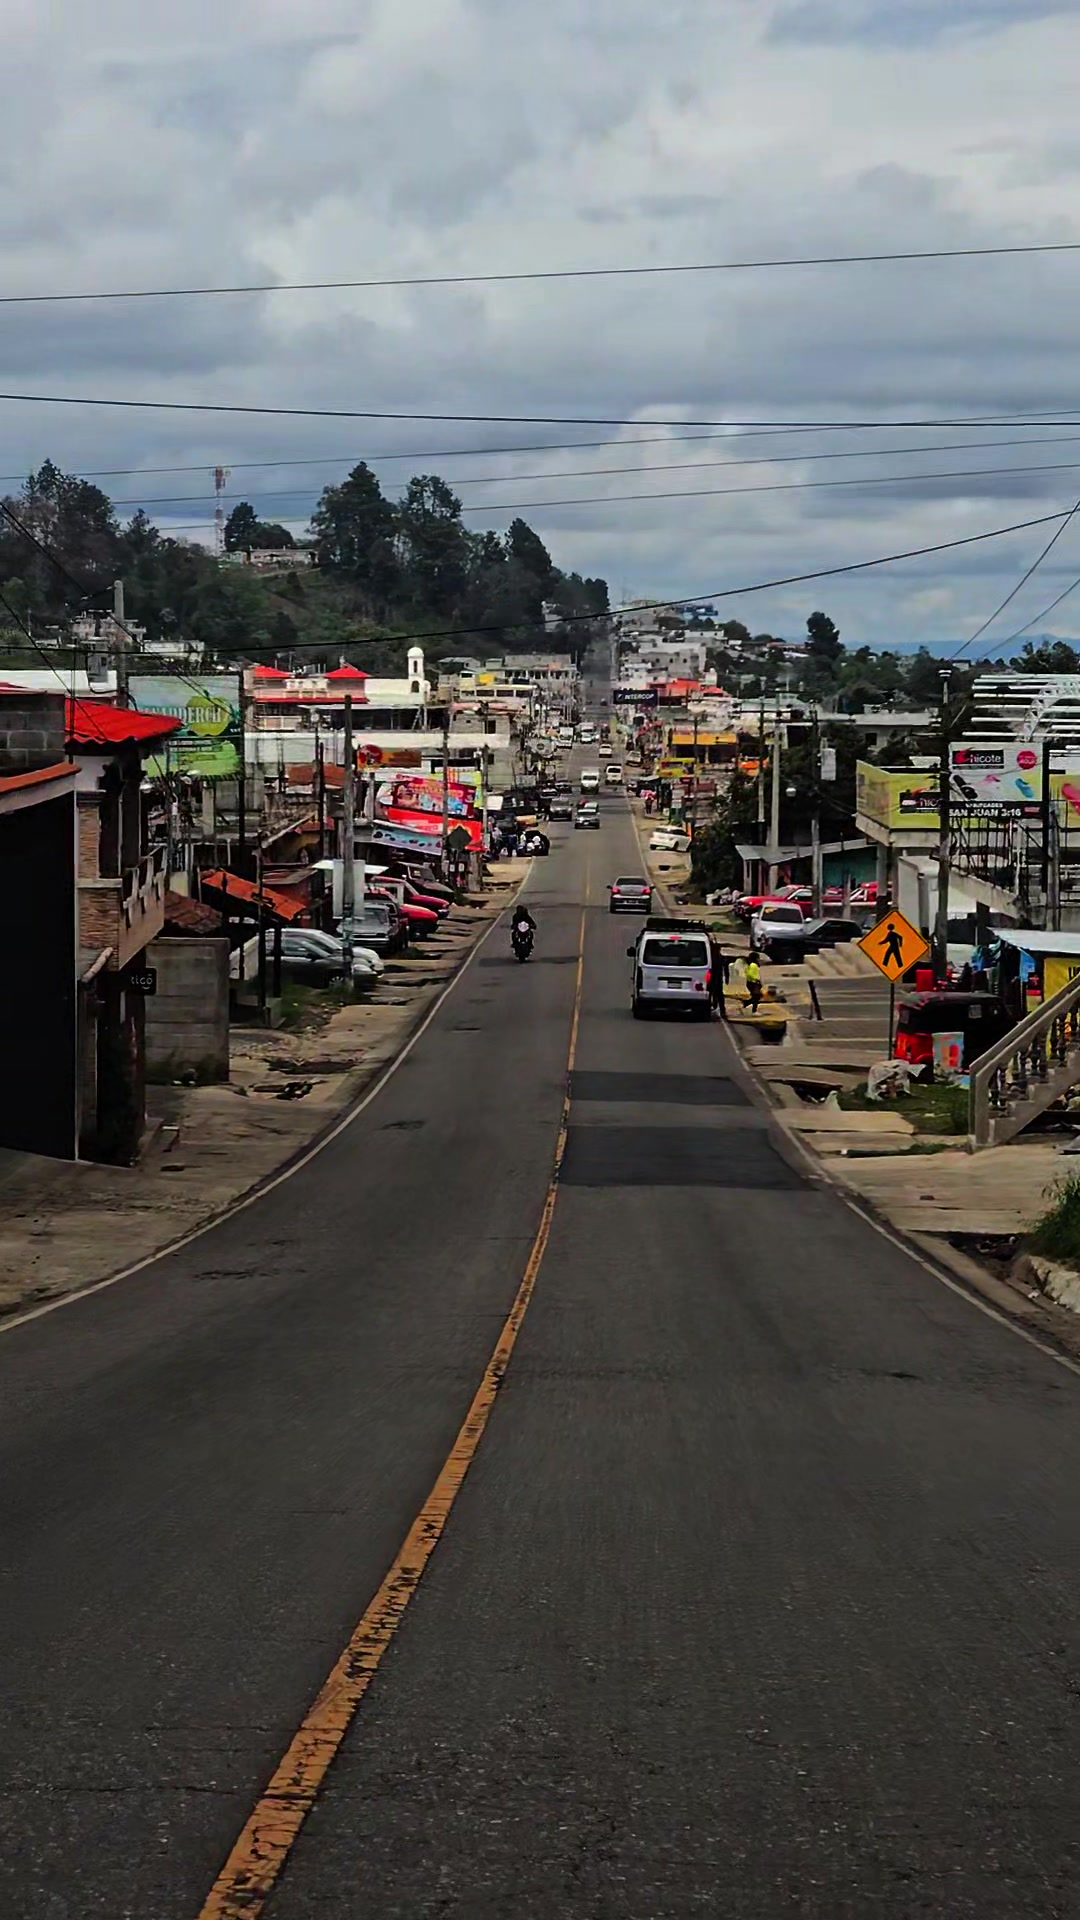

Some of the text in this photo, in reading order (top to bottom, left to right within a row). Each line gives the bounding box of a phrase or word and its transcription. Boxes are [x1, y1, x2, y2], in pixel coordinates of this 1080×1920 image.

[948, 808, 968, 817] SAN
[970, 808, 998, 817] JUAN
[1001, 808, 1021, 817] 3:16
